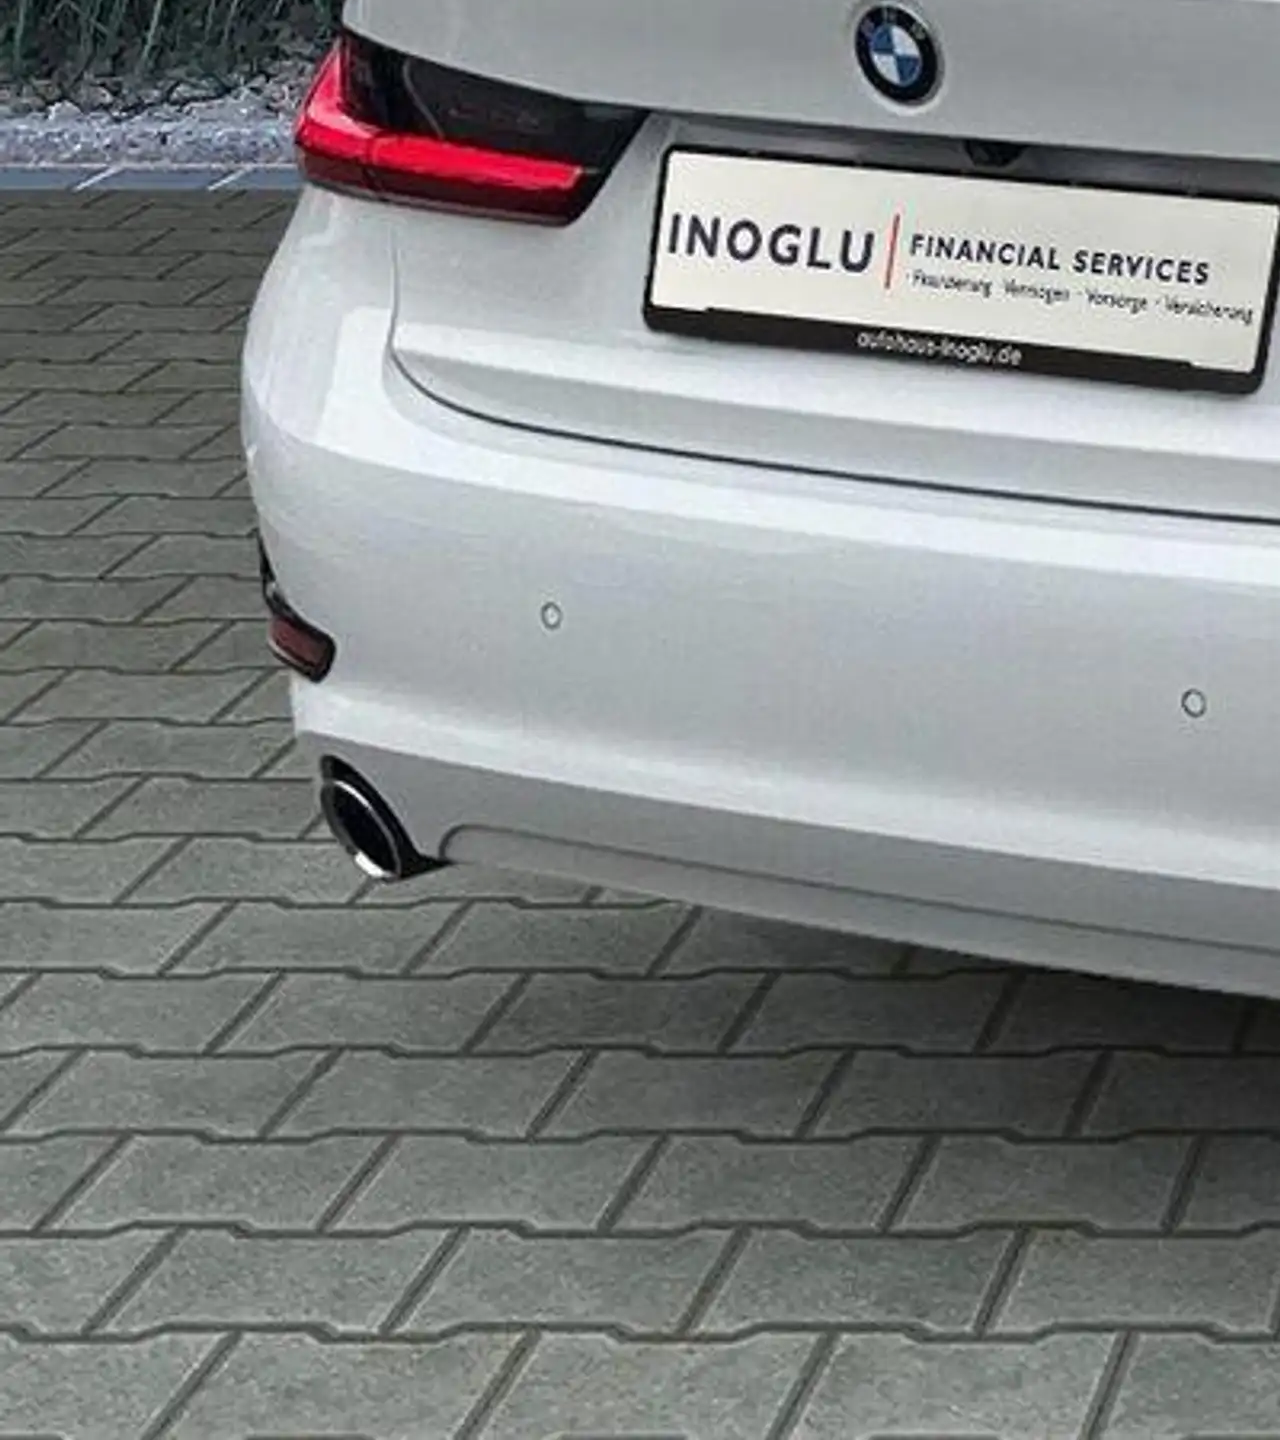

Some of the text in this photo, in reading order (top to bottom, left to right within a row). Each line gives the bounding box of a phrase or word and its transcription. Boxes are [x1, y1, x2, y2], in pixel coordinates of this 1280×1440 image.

[668, 213, 875, 273] INOGLU
[909, 233, 1210, 286] FINANCIAL SERVICES
